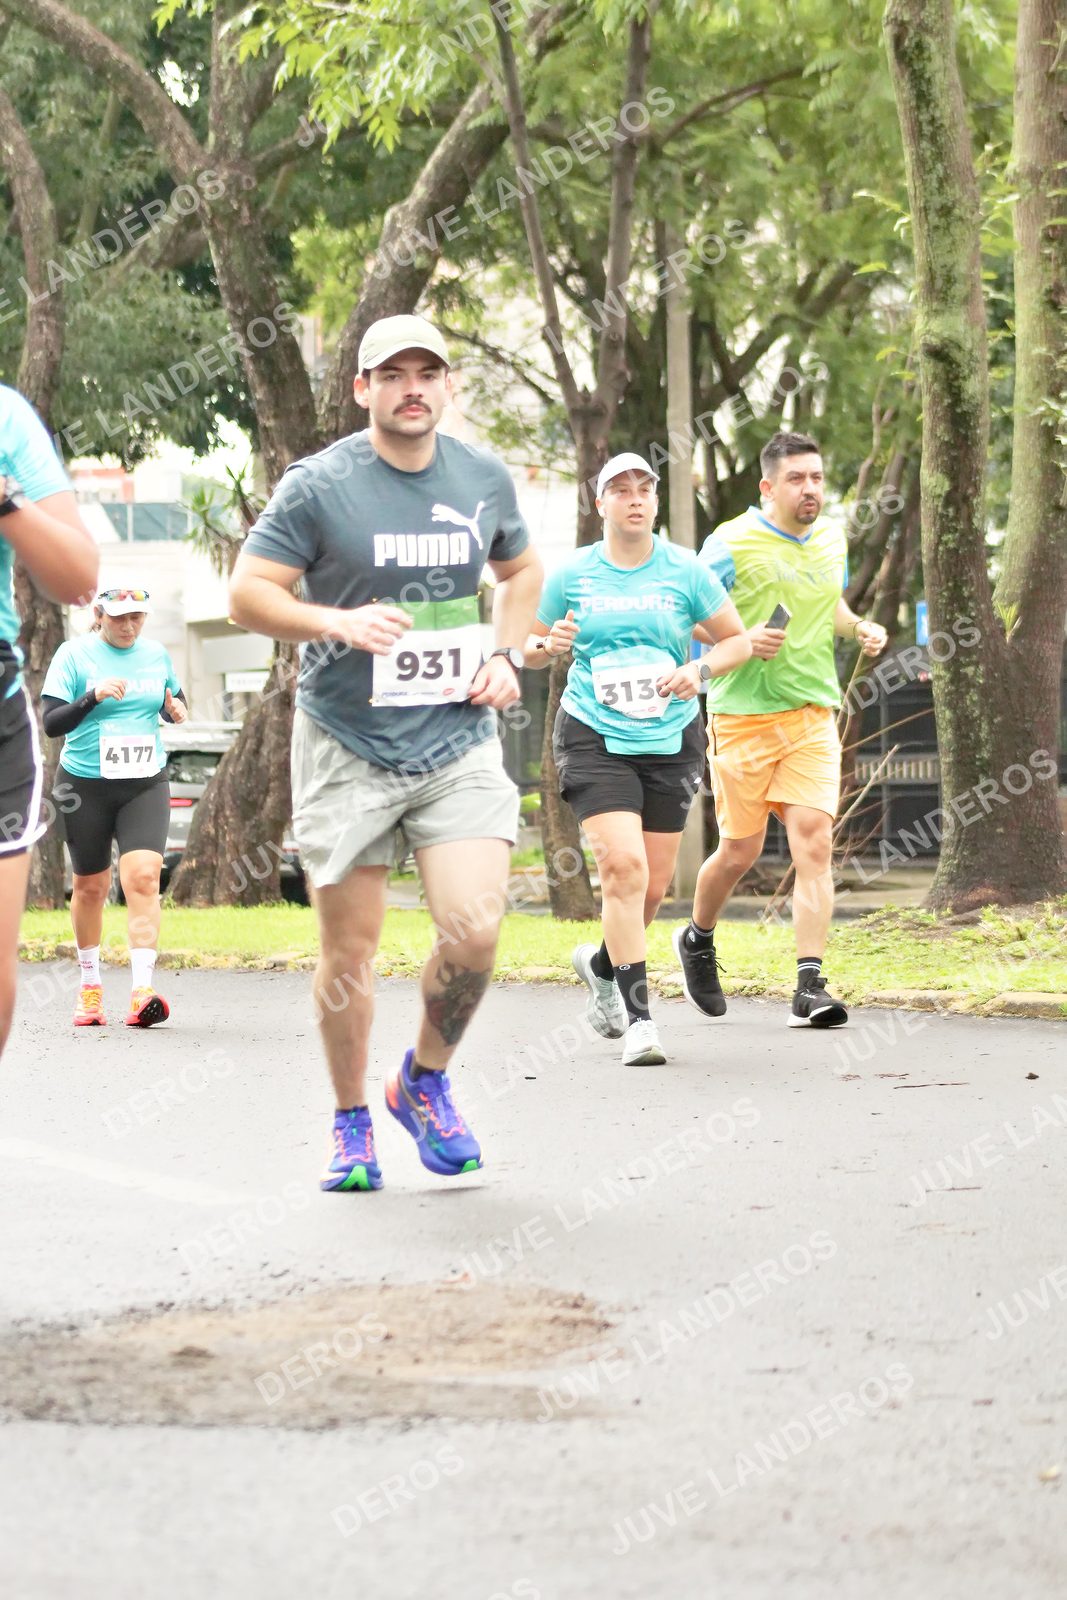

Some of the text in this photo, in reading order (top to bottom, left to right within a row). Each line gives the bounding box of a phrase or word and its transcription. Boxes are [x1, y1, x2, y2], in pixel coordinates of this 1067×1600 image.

[374, 532, 470, 567] PUMA
[579, 594, 676, 615] PERDURA
[396, 648, 461, 682] 931
[105, 746, 154, 764] 4177
